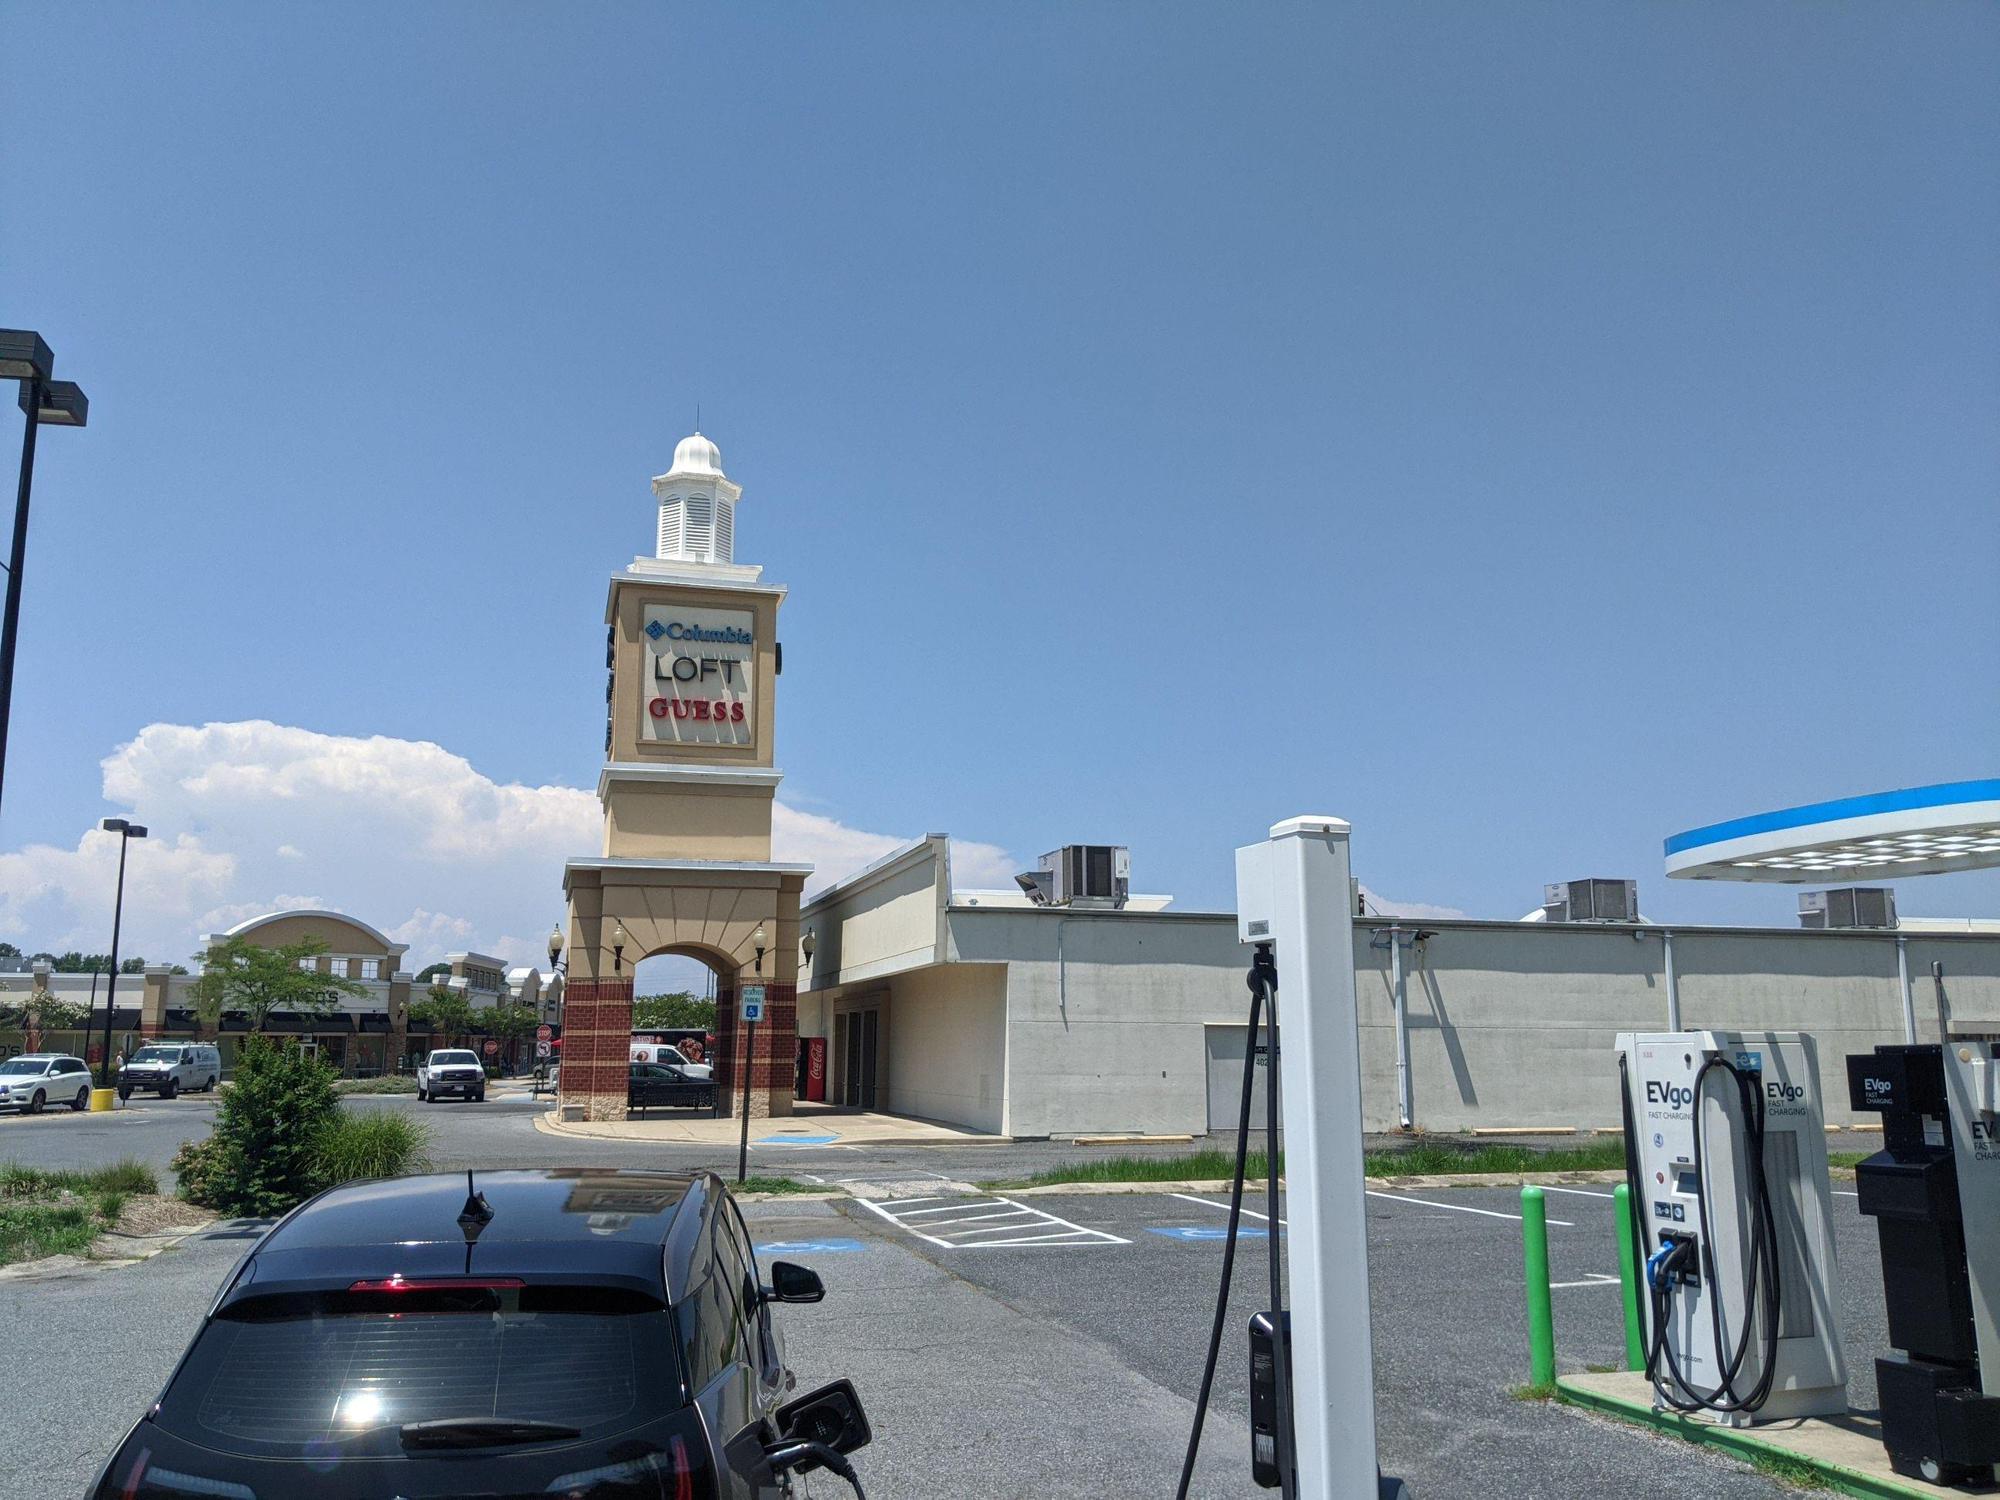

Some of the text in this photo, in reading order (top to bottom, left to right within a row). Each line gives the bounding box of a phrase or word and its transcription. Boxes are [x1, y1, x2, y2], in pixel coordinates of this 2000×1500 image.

[667, 622, 752, 644] Columbia
[655, 655, 740, 684] LOFT
[649, 697, 744, 722] GUESS
[538, 1029, 551, 1037] STOP
[810, 1044, 823, 1080] Coca-Cola
[1767, 1082, 1803, 1101] EVgo
[1864, 1078, 1892, 1093] EVgo
[1646, 1081, 1692, 1110] EVgo
[1648, 1111, 1662, 1119] FAST
[1769, 1107, 1806, 1116] CHARGING
[1974, 1141, 1993, 1151] FAST
